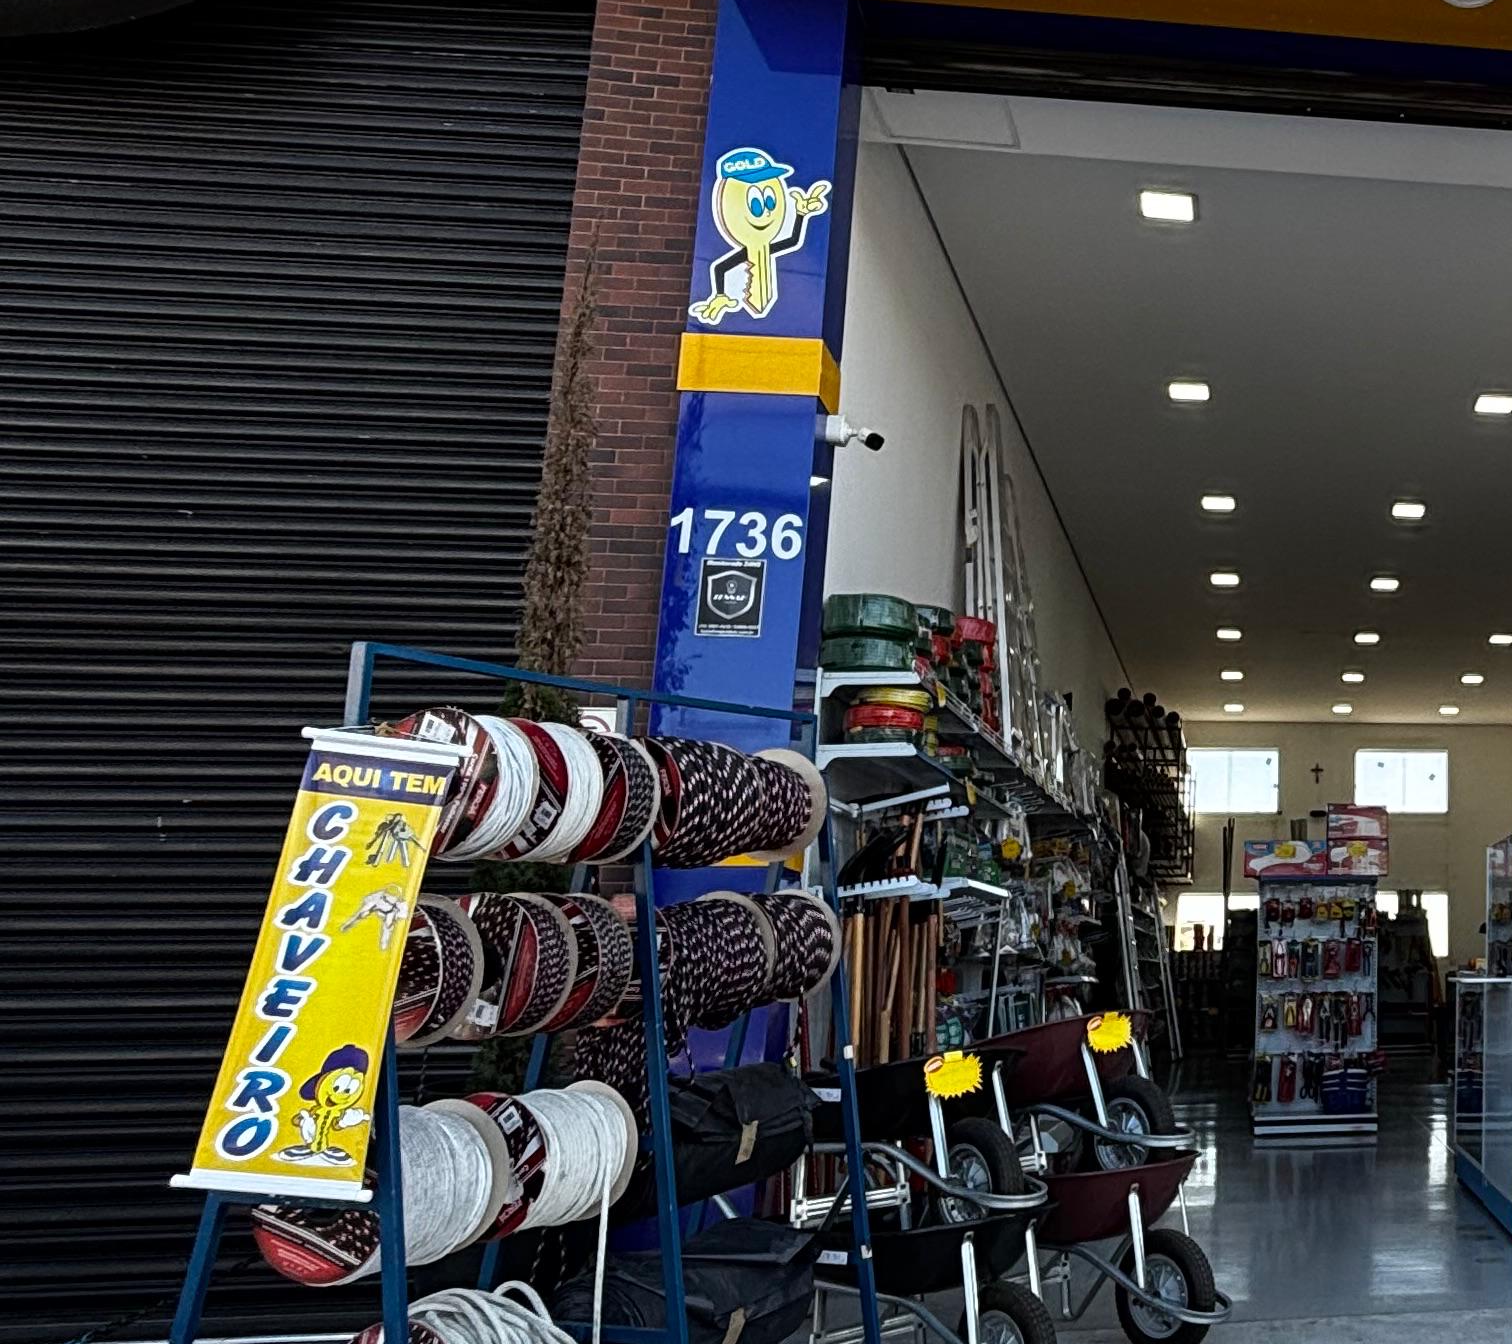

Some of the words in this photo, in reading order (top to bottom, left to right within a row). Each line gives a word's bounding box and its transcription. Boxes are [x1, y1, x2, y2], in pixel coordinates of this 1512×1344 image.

[723, 157, 766, 173] GOLD
[670, 506, 803, 559] 1736
[312, 761, 382, 789] AQUI
[390, 770, 447, 797] TEM
[215, 799, 358, 1161] CHAVEIRO
